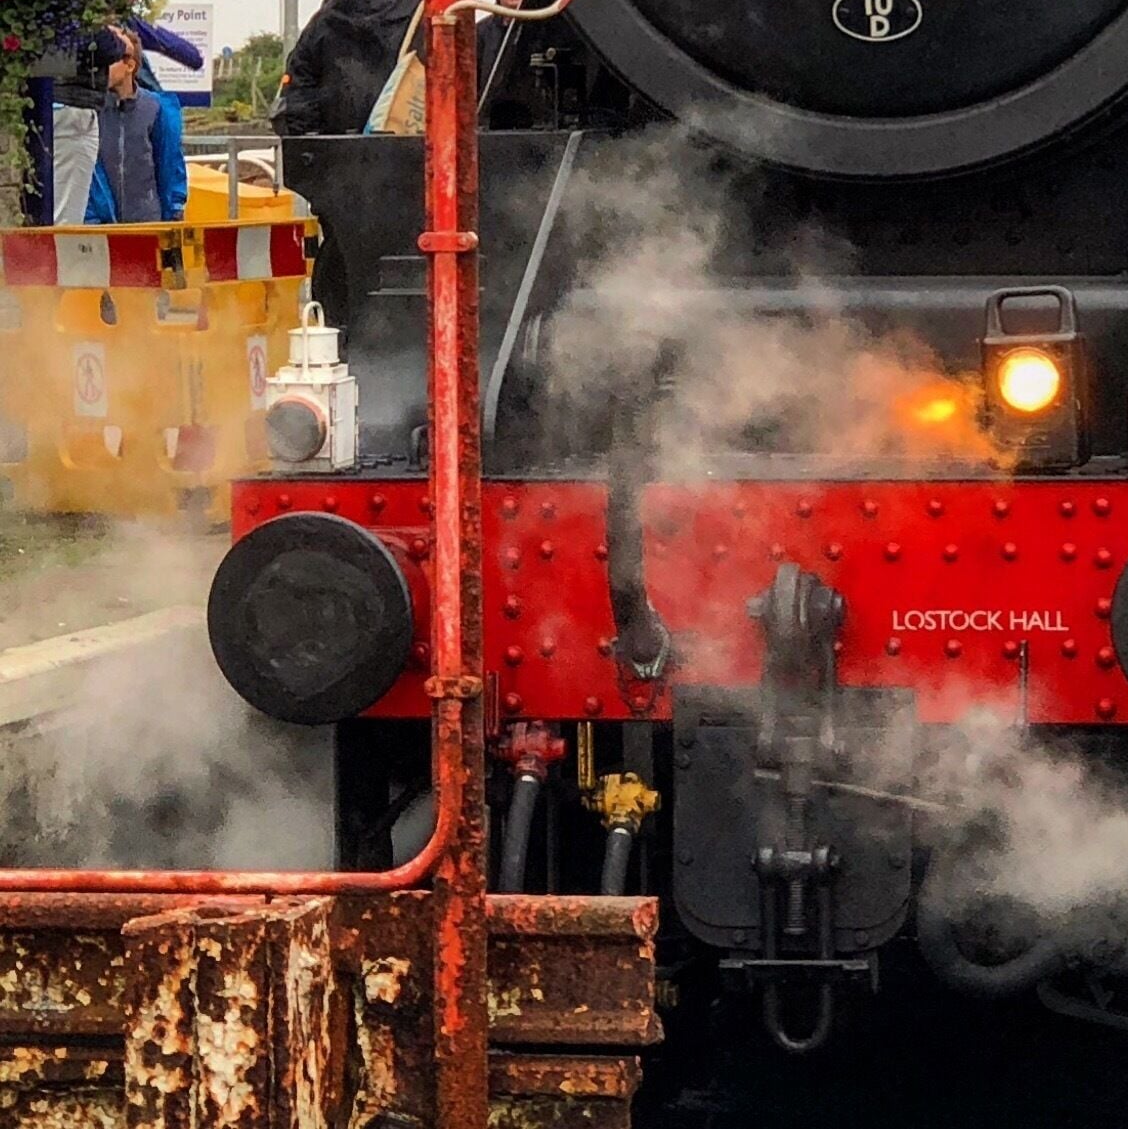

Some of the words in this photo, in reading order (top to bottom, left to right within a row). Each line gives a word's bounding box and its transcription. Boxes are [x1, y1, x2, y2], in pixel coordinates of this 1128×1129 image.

[177, 8, 207, 21] Point
[870, 15, 890, 37] D
[892, 610, 1004, 630] LOSTOCK
[1009, 610, 1069, 631] HALL
